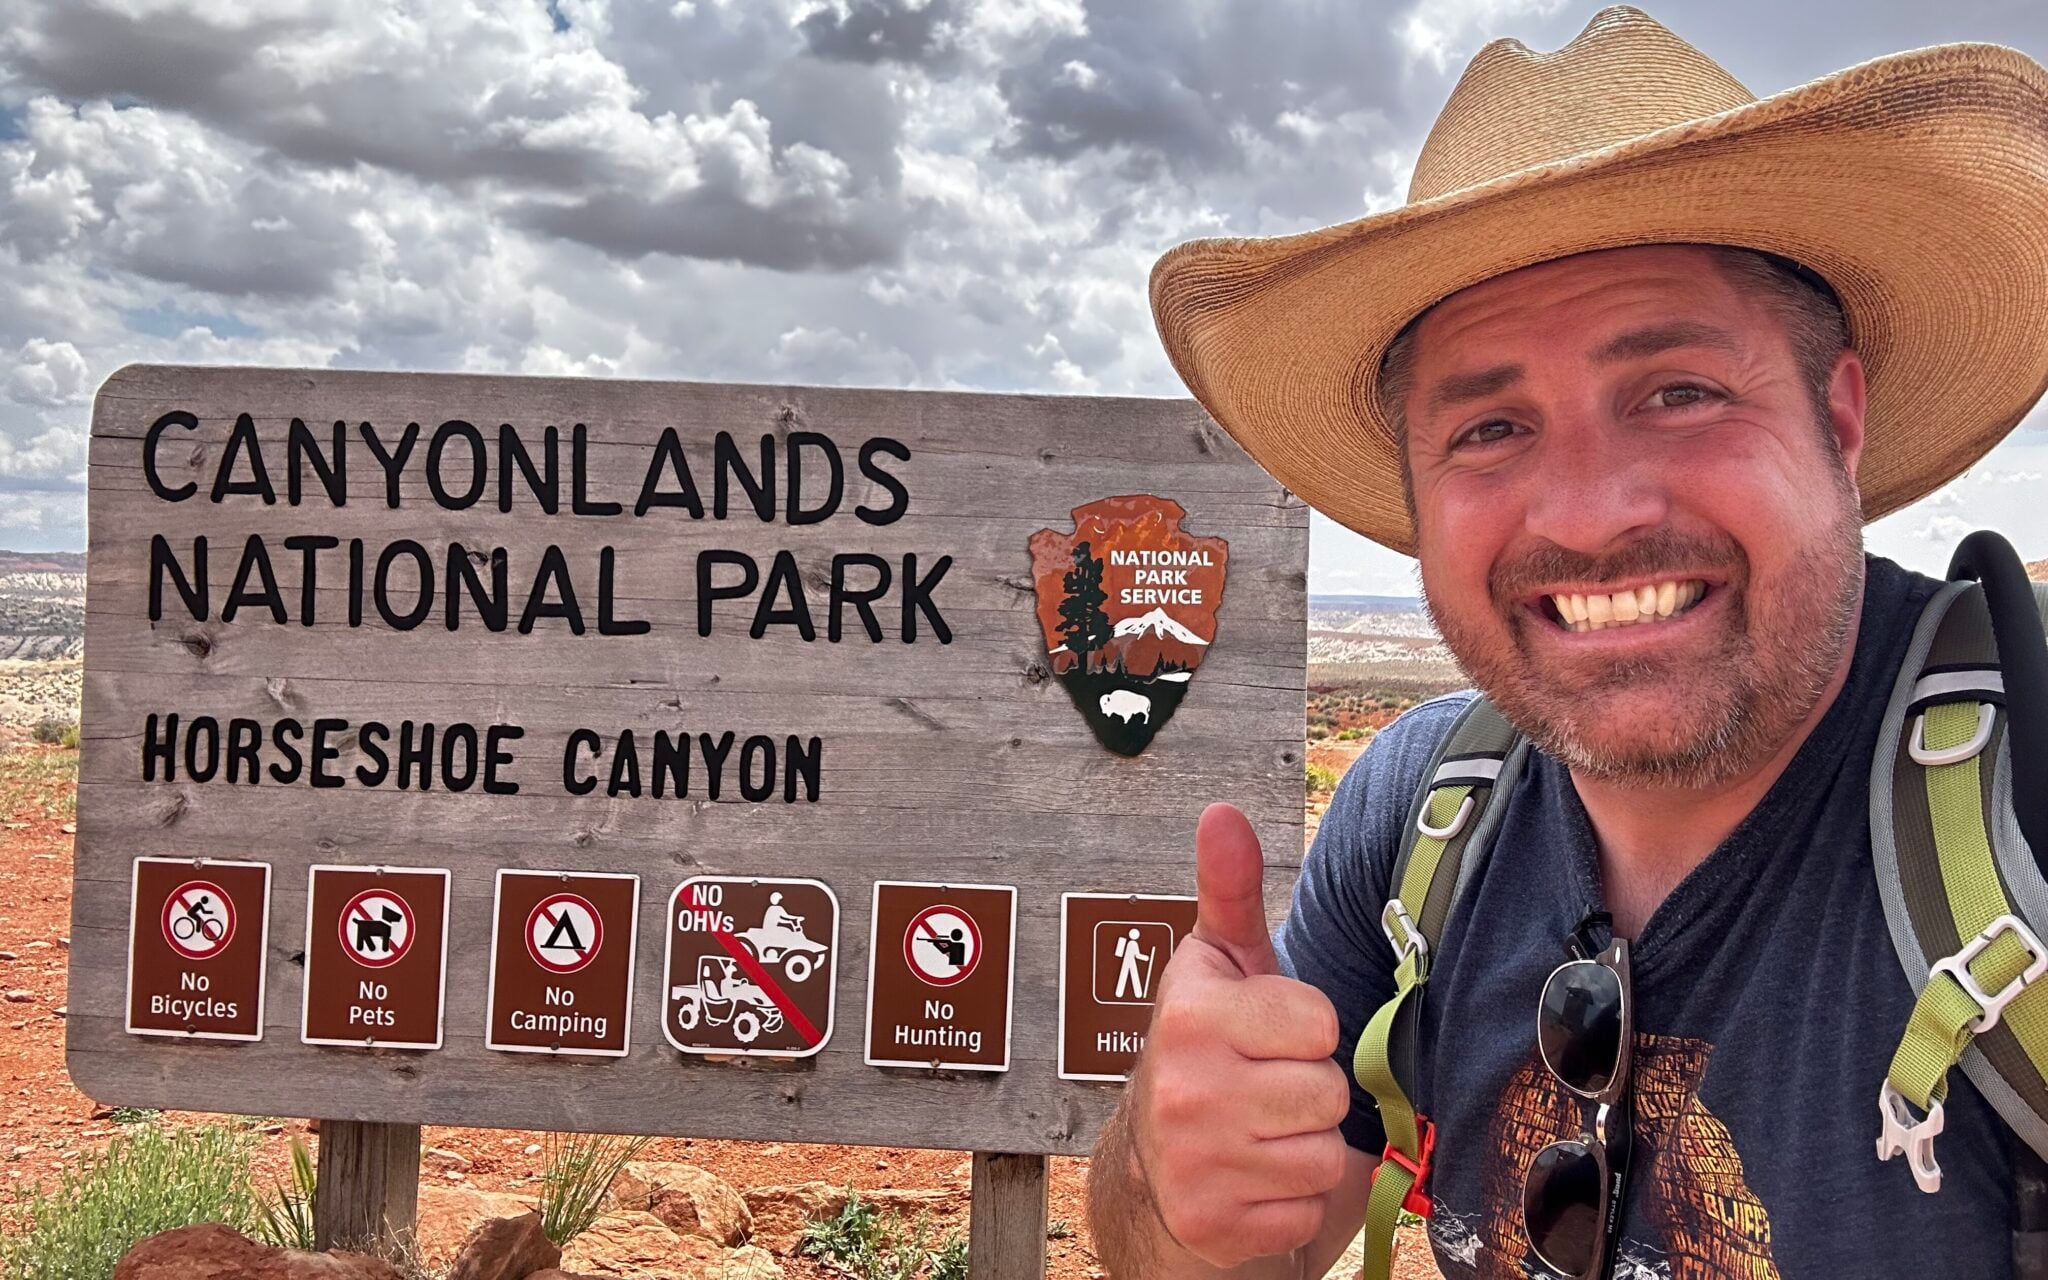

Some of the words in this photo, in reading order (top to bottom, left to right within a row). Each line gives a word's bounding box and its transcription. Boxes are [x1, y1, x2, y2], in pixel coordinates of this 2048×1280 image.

[142, 410, 911, 525] CANYONLANDS
[1110, 550, 1214, 567] NATIONAL
[1134, 569, 1188, 585] PARK
[148, 534, 651, 636] NATIONAL
[697, 550, 953, 644] PARK
[1120, 588, 1203, 605] SERVICE
[142, 712, 525, 795] HORSESHOE
[563, 728, 823, 803] CANYON
[692, 884, 723, 907] NO
[678, 909, 735, 933] OHVs
[180, 971, 210, 992] No
[359, 980, 388, 1001] No
[545, 986, 575, 1006] No
[150, 995, 238, 1021] Bicycles
[349, 1005, 396, 1027] Pets
[924, 1000, 954, 1020] No
[510, 1010, 608, 1039] Camping
[894, 1024, 982, 1053] Hunting
